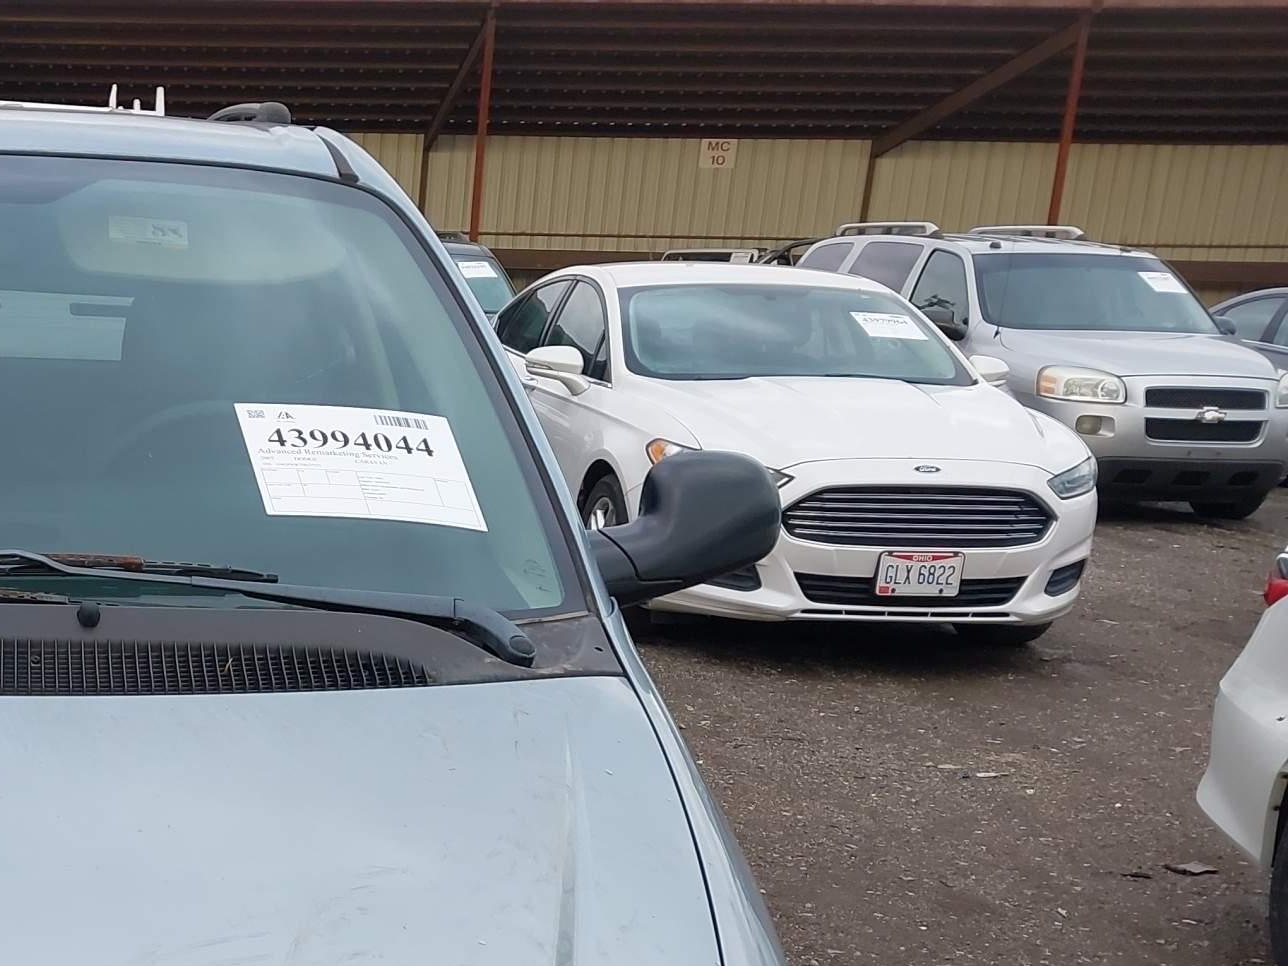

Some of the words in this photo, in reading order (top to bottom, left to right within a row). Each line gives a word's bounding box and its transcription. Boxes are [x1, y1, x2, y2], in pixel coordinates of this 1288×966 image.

[707, 141, 730, 151] MC
[712, 155, 726, 165] 10
[267, 427, 435, 457] 43994044
[304, 449, 360, 458] Remarketing
[361, 451, 399, 460] Services
[884, 565, 913, 584] GLX
[917, 565, 956, 585] 6822
